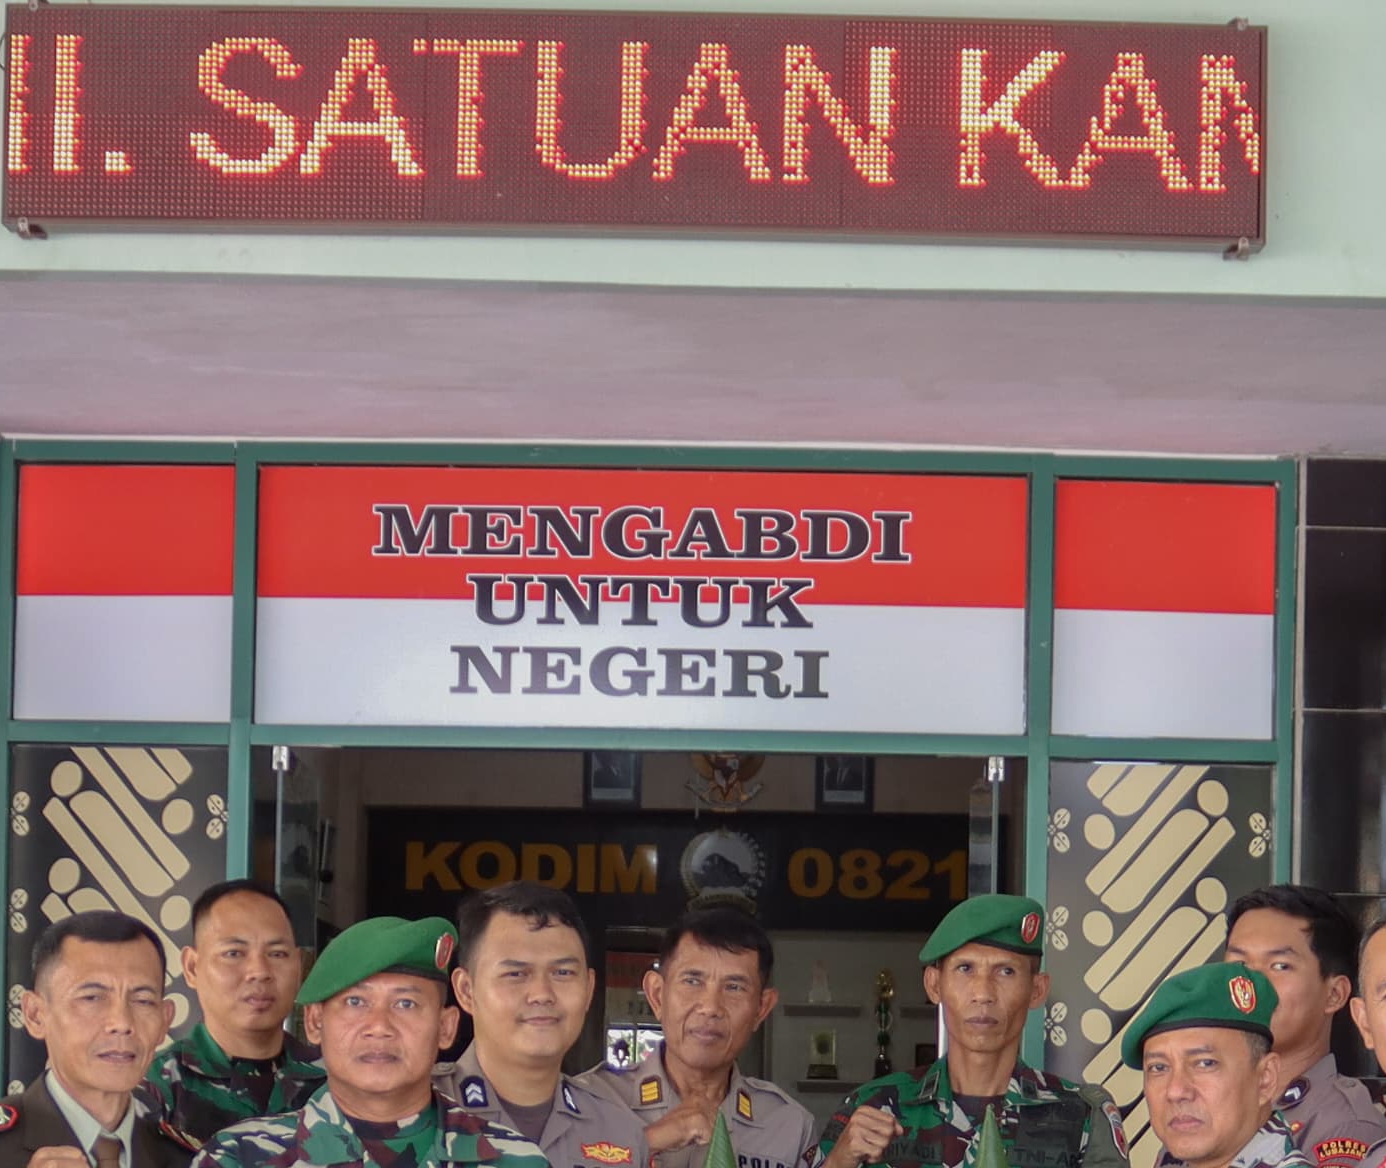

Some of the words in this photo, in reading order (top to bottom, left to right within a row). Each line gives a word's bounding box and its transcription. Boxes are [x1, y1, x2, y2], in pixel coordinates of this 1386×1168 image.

[189, 36, 897, 187] SATUAN
[371, 502, 912, 564] MENGABDI
[466, 573, 815, 629] UNTUK
[449, 645, 830, 699] NEGERI
[405, 840, 658, 894] KODIM
[787, 847, 969, 899] 0821
